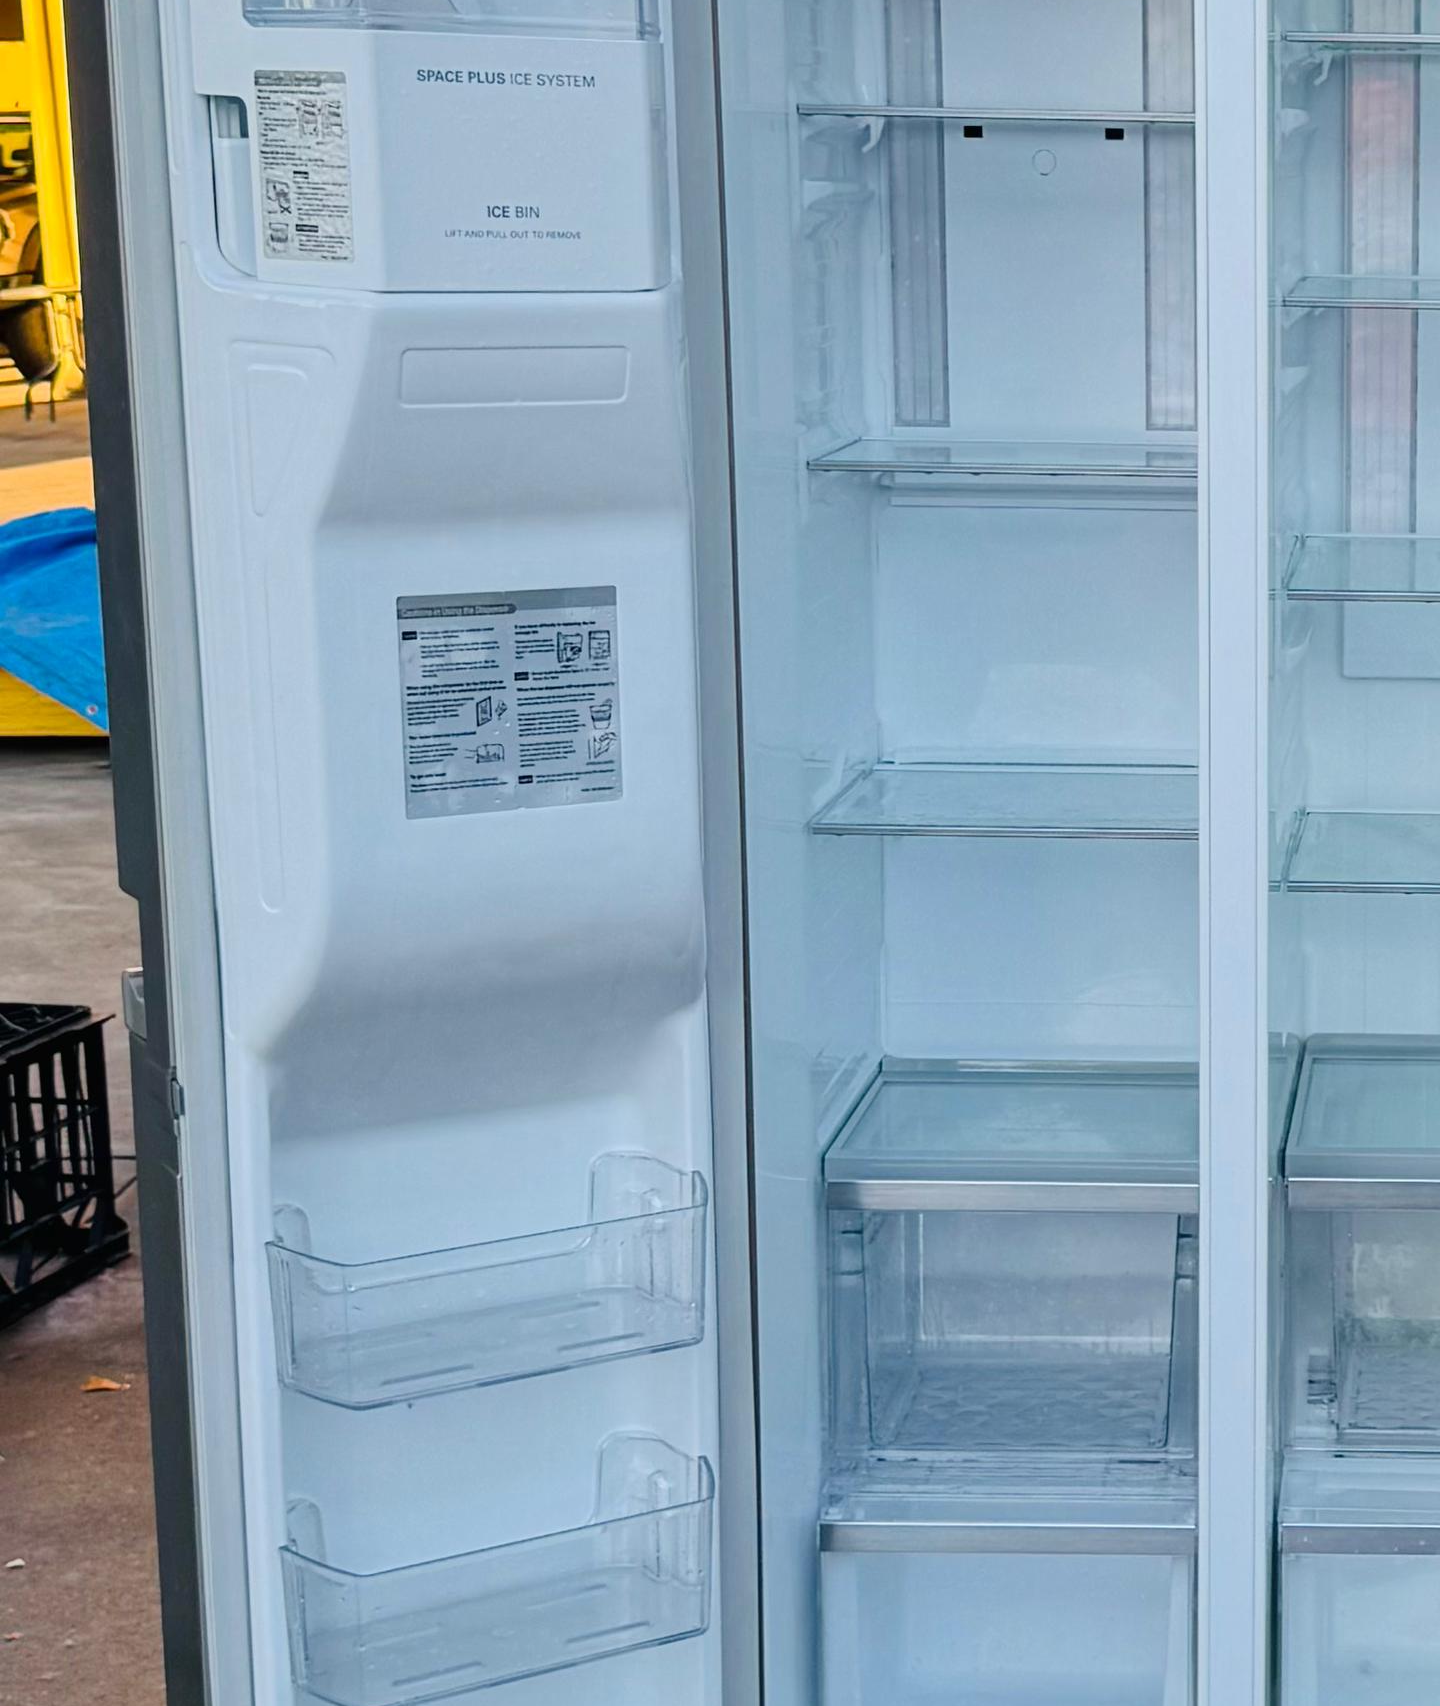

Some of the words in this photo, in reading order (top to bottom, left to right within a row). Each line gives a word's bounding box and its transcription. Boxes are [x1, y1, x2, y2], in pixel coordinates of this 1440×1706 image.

[416, 69, 464, 83] SPACE
[467, 70, 506, 85] PLUS
[510, 72, 532, 86] ICE
[536, 73, 596, 88] SYSTEM
[487, 205, 511, 219] ICE
[515, 205, 540, 219] BIN
[444, 228, 462, 238] LIFT
[464, 229, 484, 239] AND
[486, 229, 507, 239] PULL
[510, 230, 529, 239] OUT
[532, 230, 544, 239] TO
[546, 230, 582, 240] REMOVE
